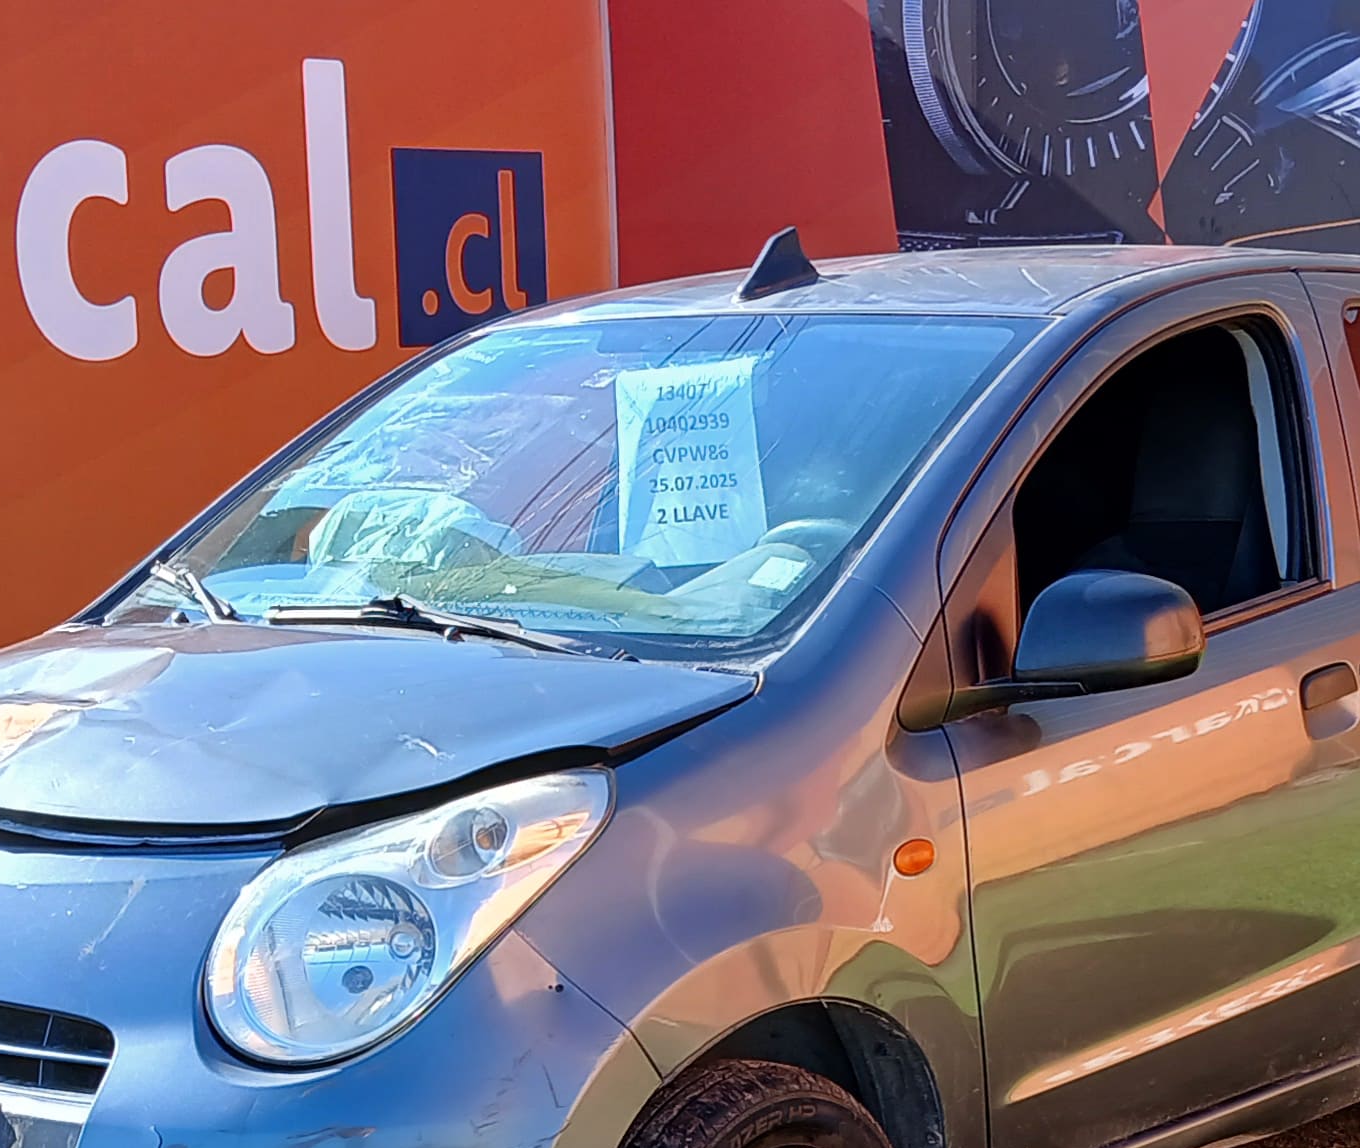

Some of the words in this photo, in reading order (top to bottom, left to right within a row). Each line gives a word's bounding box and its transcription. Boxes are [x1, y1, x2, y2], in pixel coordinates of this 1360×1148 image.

[646, 412, 730, 434] 10402939
[652, 444, 729, 465] CVPW86
[649, 473, 738, 493] 25.07.2025
[657, 508, 668, 524] 2
[674, 503, 730, 523] LLAVE
